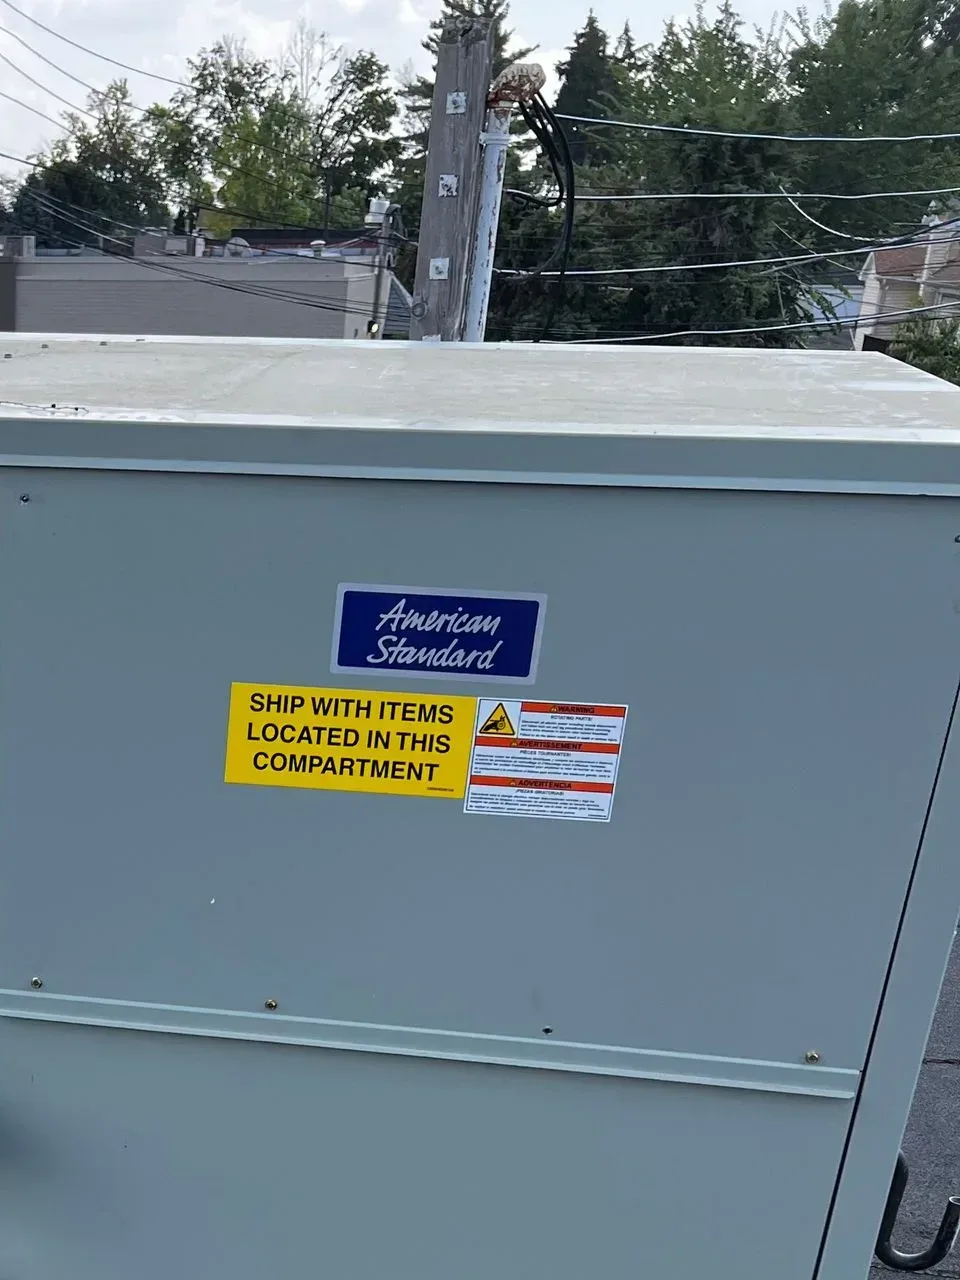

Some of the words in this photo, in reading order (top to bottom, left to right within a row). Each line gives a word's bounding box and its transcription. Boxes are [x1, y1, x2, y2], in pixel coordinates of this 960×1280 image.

[376, 599, 501, 635] American
[366, 635, 503, 669] Standard
[250, 693, 304, 714] SHIP
[311, 697, 371, 719] WITH
[379, 701, 453, 724] ITEMS
[247, 723, 359, 747] LOCATED
[367, 730, 389, 749] IN
[396, 732, 450, 754] THIS
[519, 740, 582, 749] AVERTISSEMENT
[253, 752, 439, 781] COMPARTMENT
[518, 780, 571, 788] ADVERTENCIA
